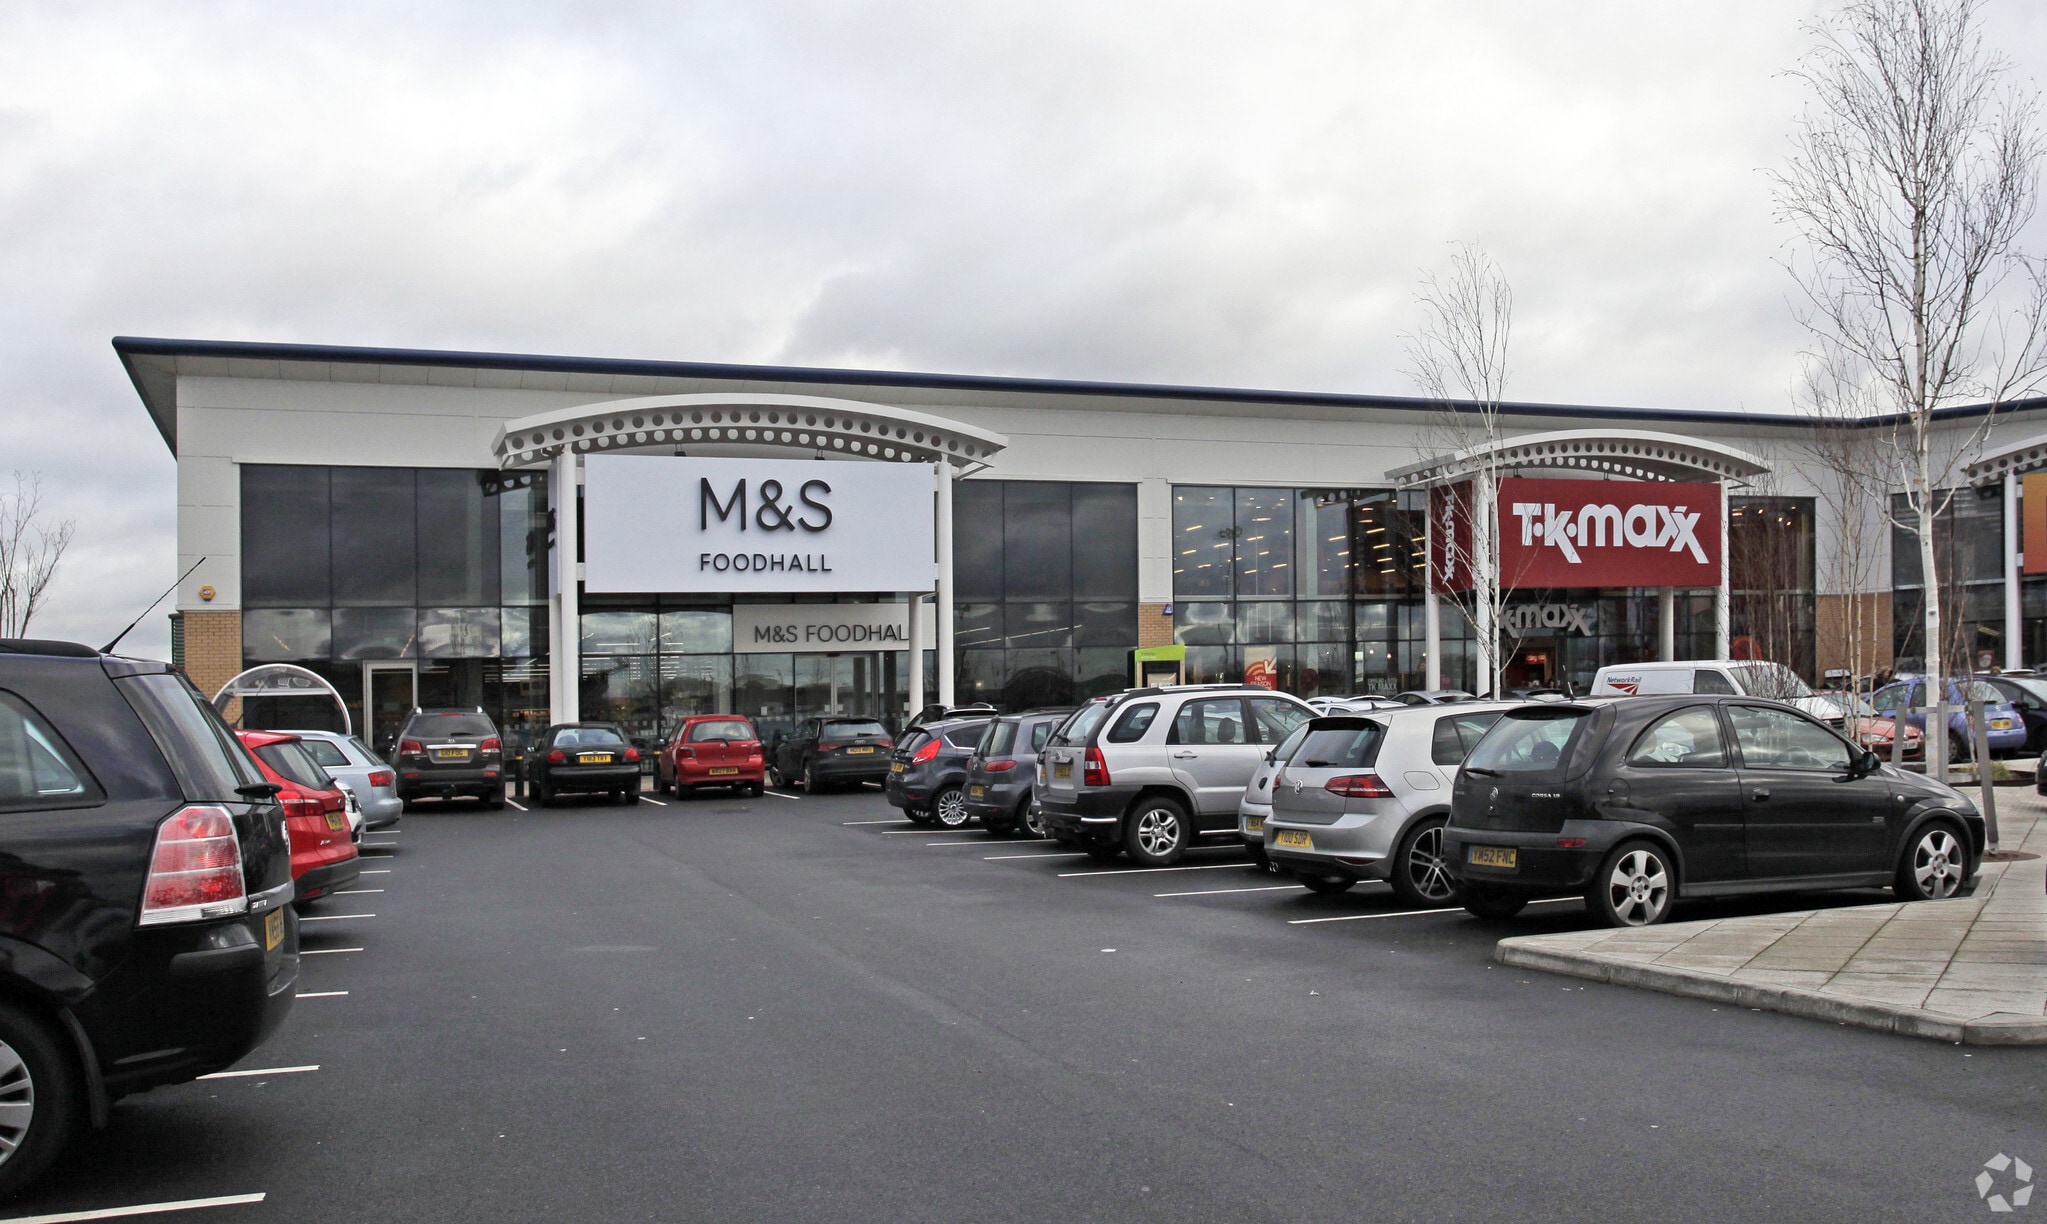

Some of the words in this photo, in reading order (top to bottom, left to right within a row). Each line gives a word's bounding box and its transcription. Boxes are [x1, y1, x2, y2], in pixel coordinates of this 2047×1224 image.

[700, 476, 833, 532] M&S
[700, 553, 833, 572] FOODHALL
[754, 625, 798, 643] M&S
